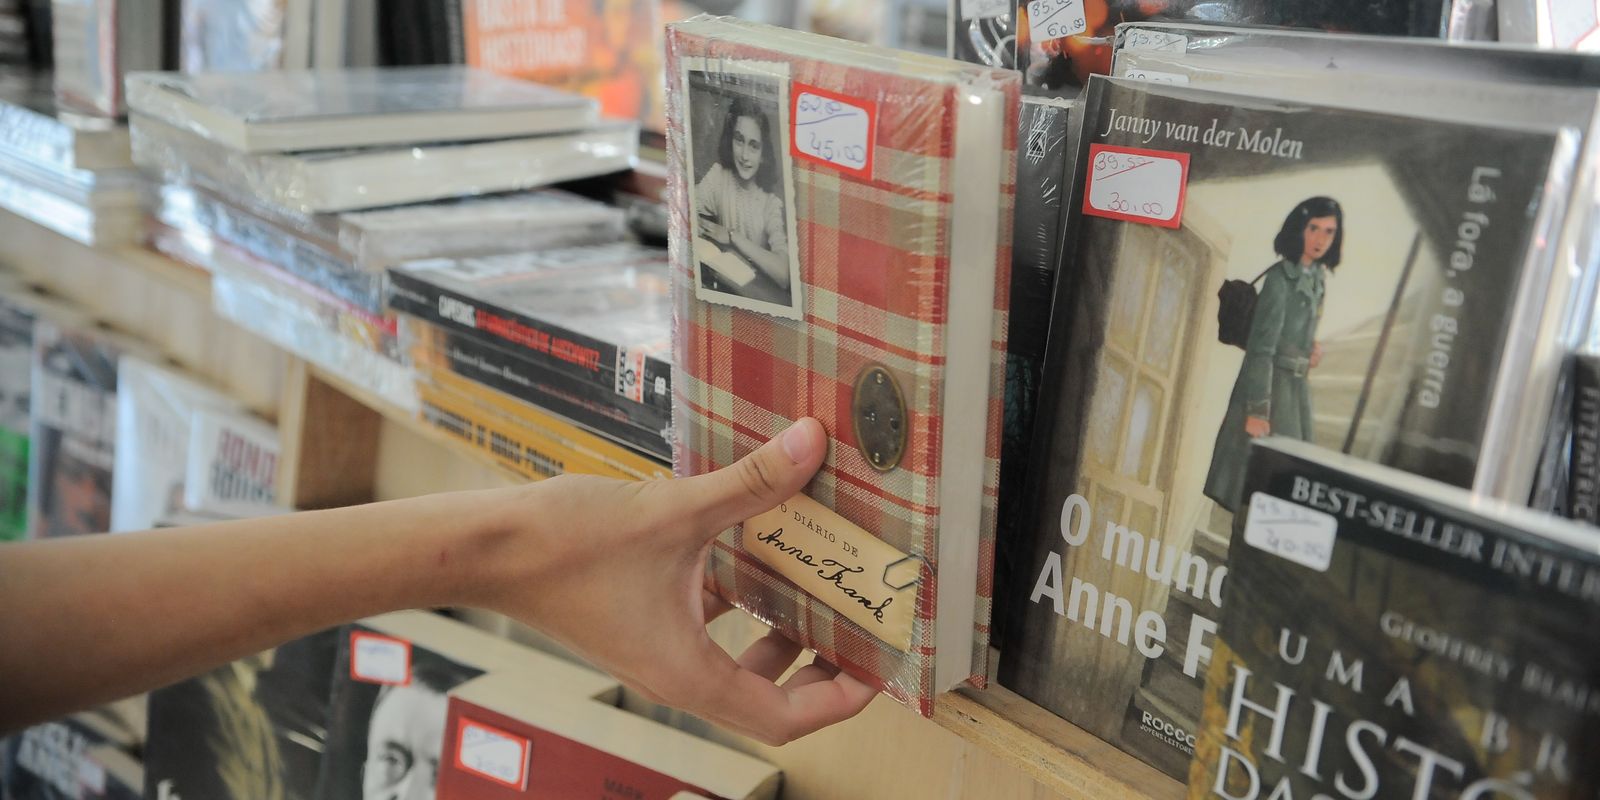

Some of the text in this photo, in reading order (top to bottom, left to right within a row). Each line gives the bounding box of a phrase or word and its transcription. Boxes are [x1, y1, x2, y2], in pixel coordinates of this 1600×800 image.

[1101, 108, 1304, 159] Janny van der Molen
[1418, 165, 1502, 409] Lá fora, a guerra
[780, 503, 859, 558] O DIÁRIO DE
[1060, 493, 1091, 547] O
[1290, 475, 1486, 563] BEST-SELLER
[756, 527, 893, 624] Anne Frank
[1029, 550, 1167, 660] Anne
[1223, 662, 1545, 800] HIST
